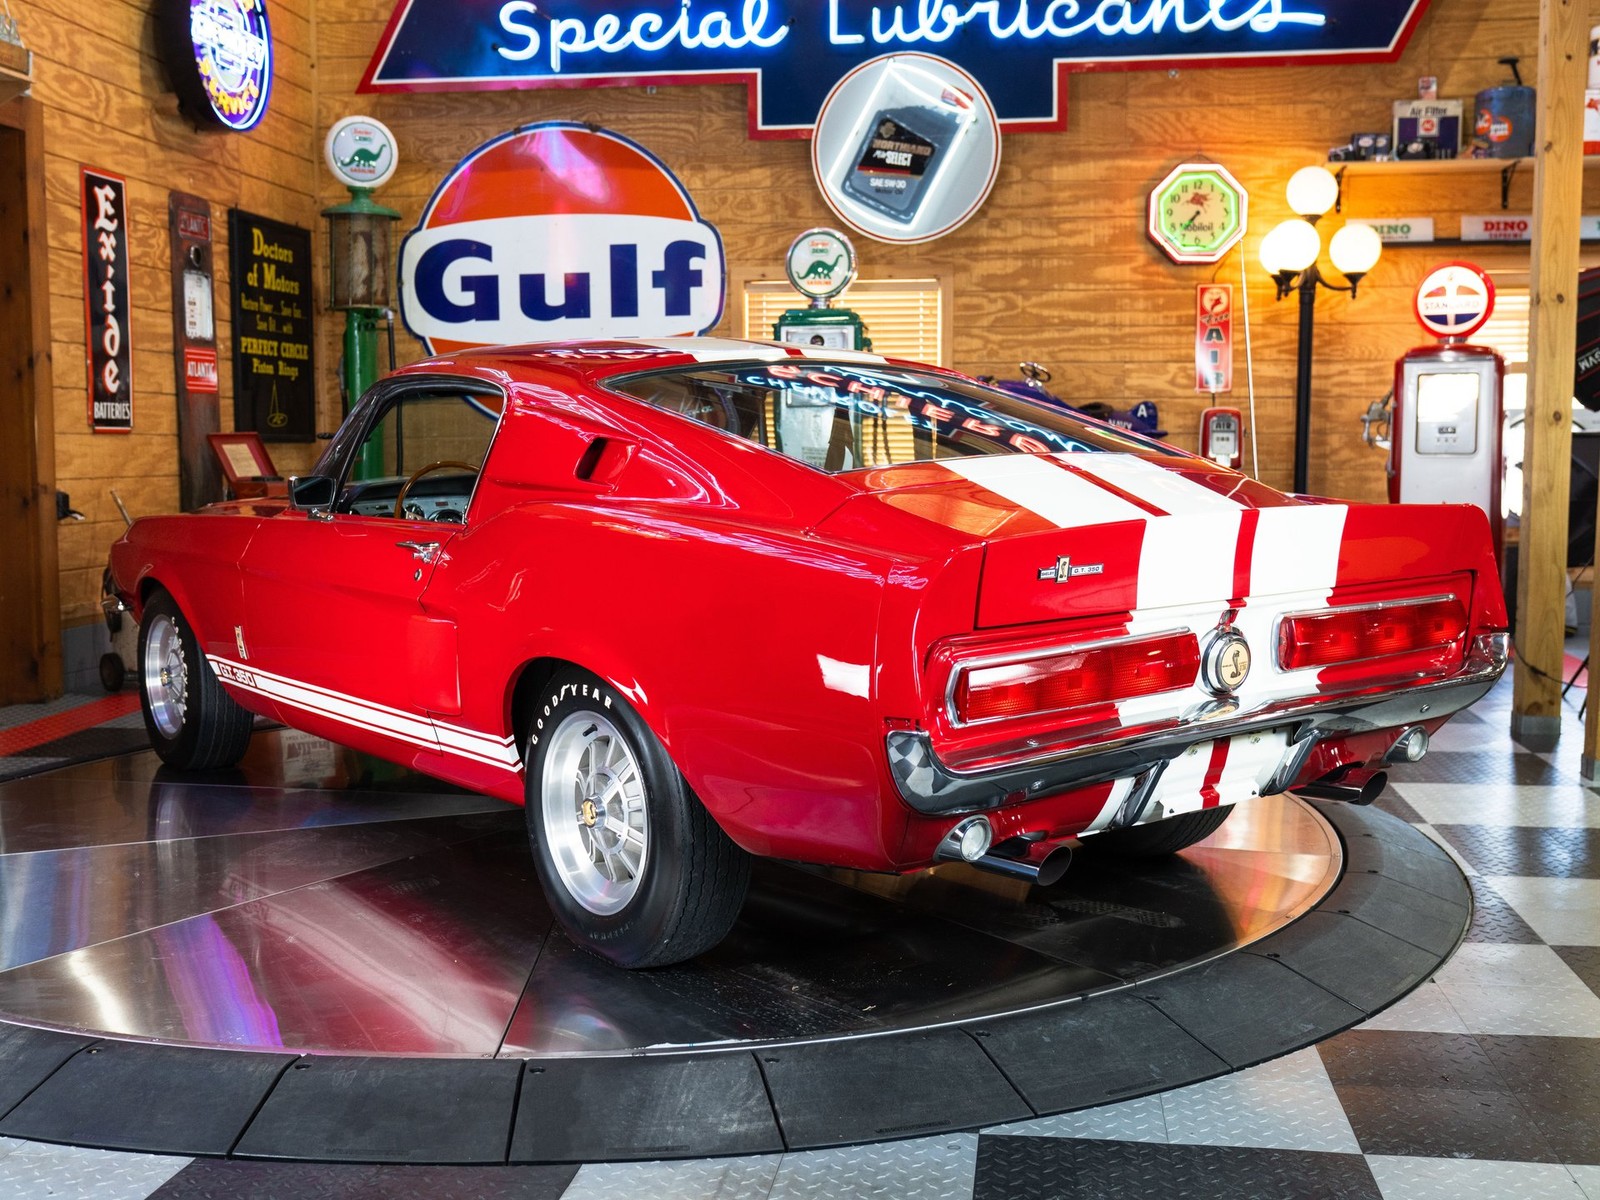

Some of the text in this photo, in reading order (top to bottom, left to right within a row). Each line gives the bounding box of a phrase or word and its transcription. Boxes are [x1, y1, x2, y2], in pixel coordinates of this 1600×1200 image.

[498, 0, 1326, 72] Special Lubricants
[1181, 185, 1189, 193] 11
[1194, 180, 1203, 190] 12
[1170, 194, 1181, 203] 10
[1166, 208, 1174, 217] 9
[1483, 220, 1529, 232] DINO
[252, 227, 294, 264] Doctors
[247, 262, 300, 295] of Motors
[414, 238, 706, 324] Gulf
[241, 336, 309, 360] PERFECT CIRCLE
[187, 360, 215, 380] ATLANTIC
[252, 358, 299, 381] Piston Rings
[93, 401, 131, 421] BATTERIES
[1137, 404, 1148, 418] A
[233, 668, 256, 687] 350
[531, 684, 612, 745] GOODYEAR
